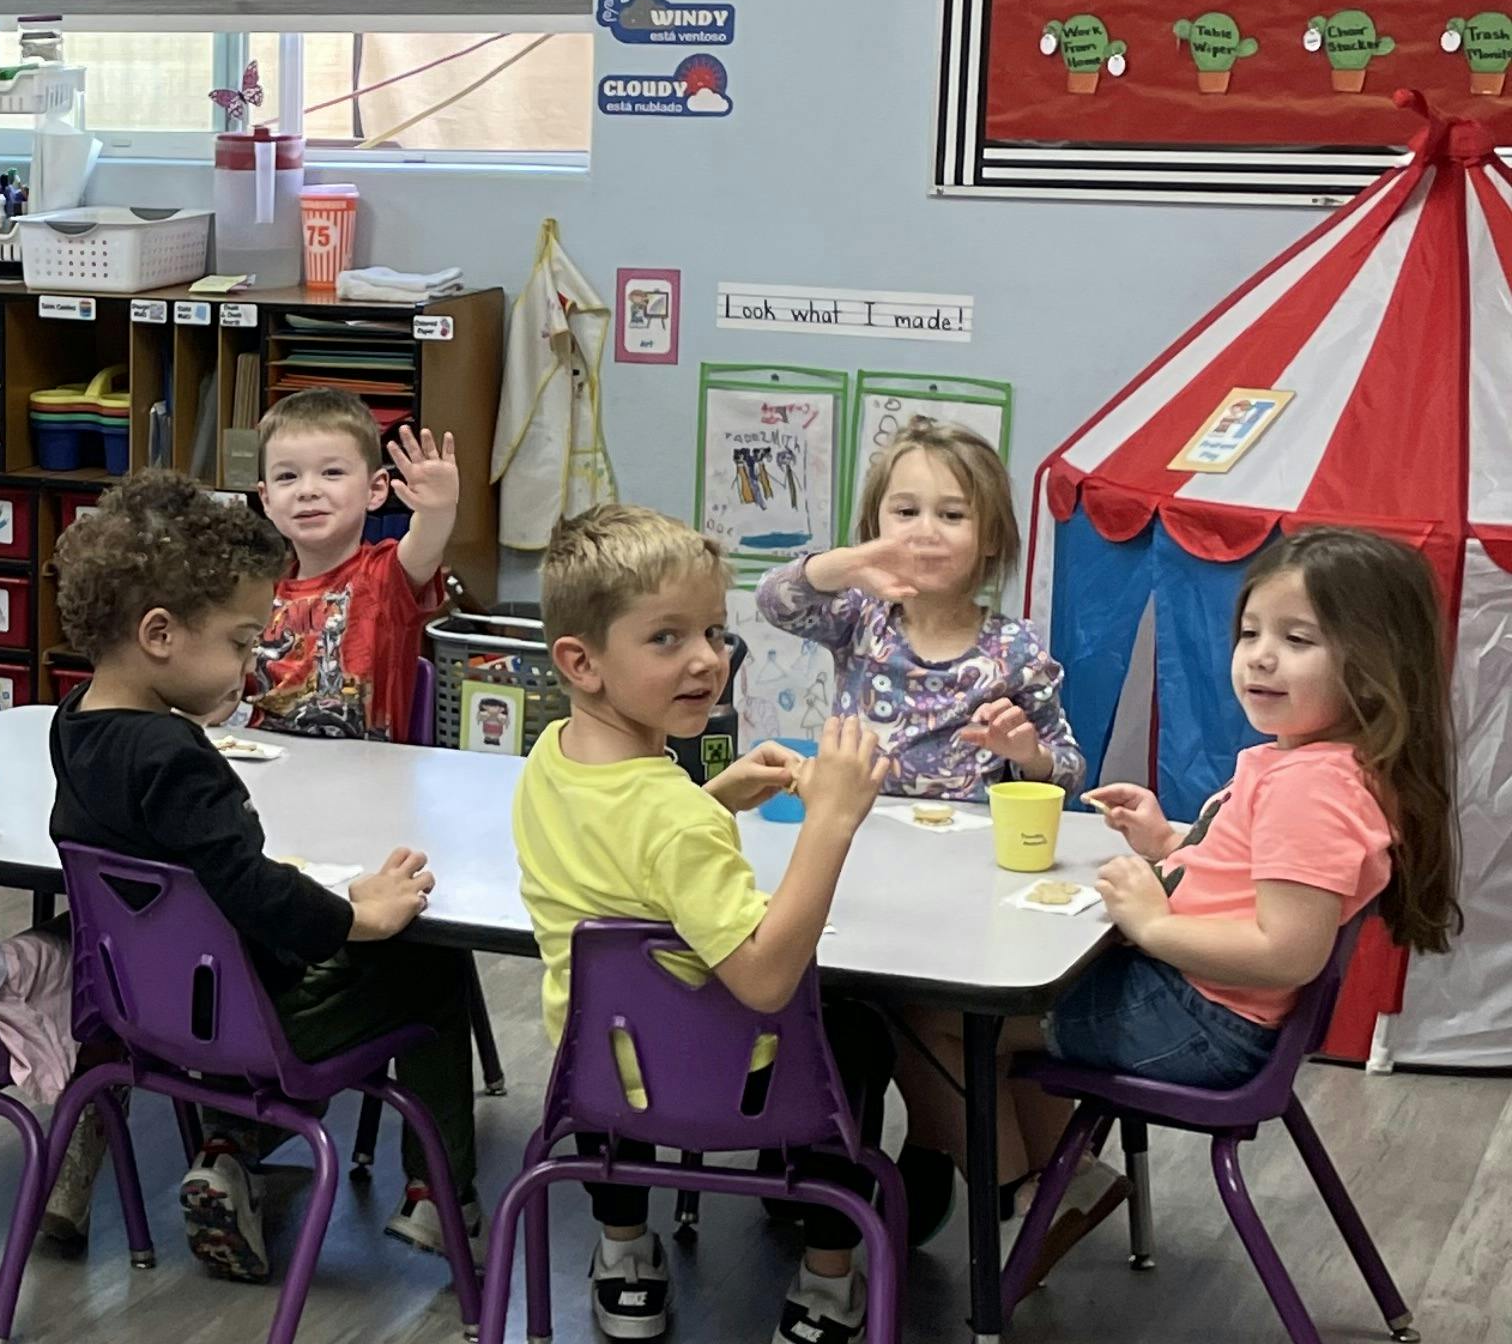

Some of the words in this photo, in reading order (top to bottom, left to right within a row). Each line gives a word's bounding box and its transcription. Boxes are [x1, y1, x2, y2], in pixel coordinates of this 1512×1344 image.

[651, 10, 728, 26] WINDY
[650, 31, 676, 42] está
[678, 31, 726, 42] ventoso
[1063, 26, 1102, 37] Work
[1196, 25, 1232, 39] Table
[1328, 26, 1368, 38] Chair
[1468, 26, 1510, 41] Trash
[1063, 42, 1096, 53] From
[1193, 42, 1236, 57] Wiper
[1328, 39, 1381, 52] Stacker
[1068, 57, 1100, 68] Home
[603, 81, 688, 97] CLOUDY
[606, 102, 632, 112] está
[634, 102, 683, 113] nublado
[306, 225, 331, 247] 75
[725, 294, 776, 321] Look
[790, 300, 843, 324] what
[864, 301, 876, 326] I
[894, 306, 964, 332] made!
